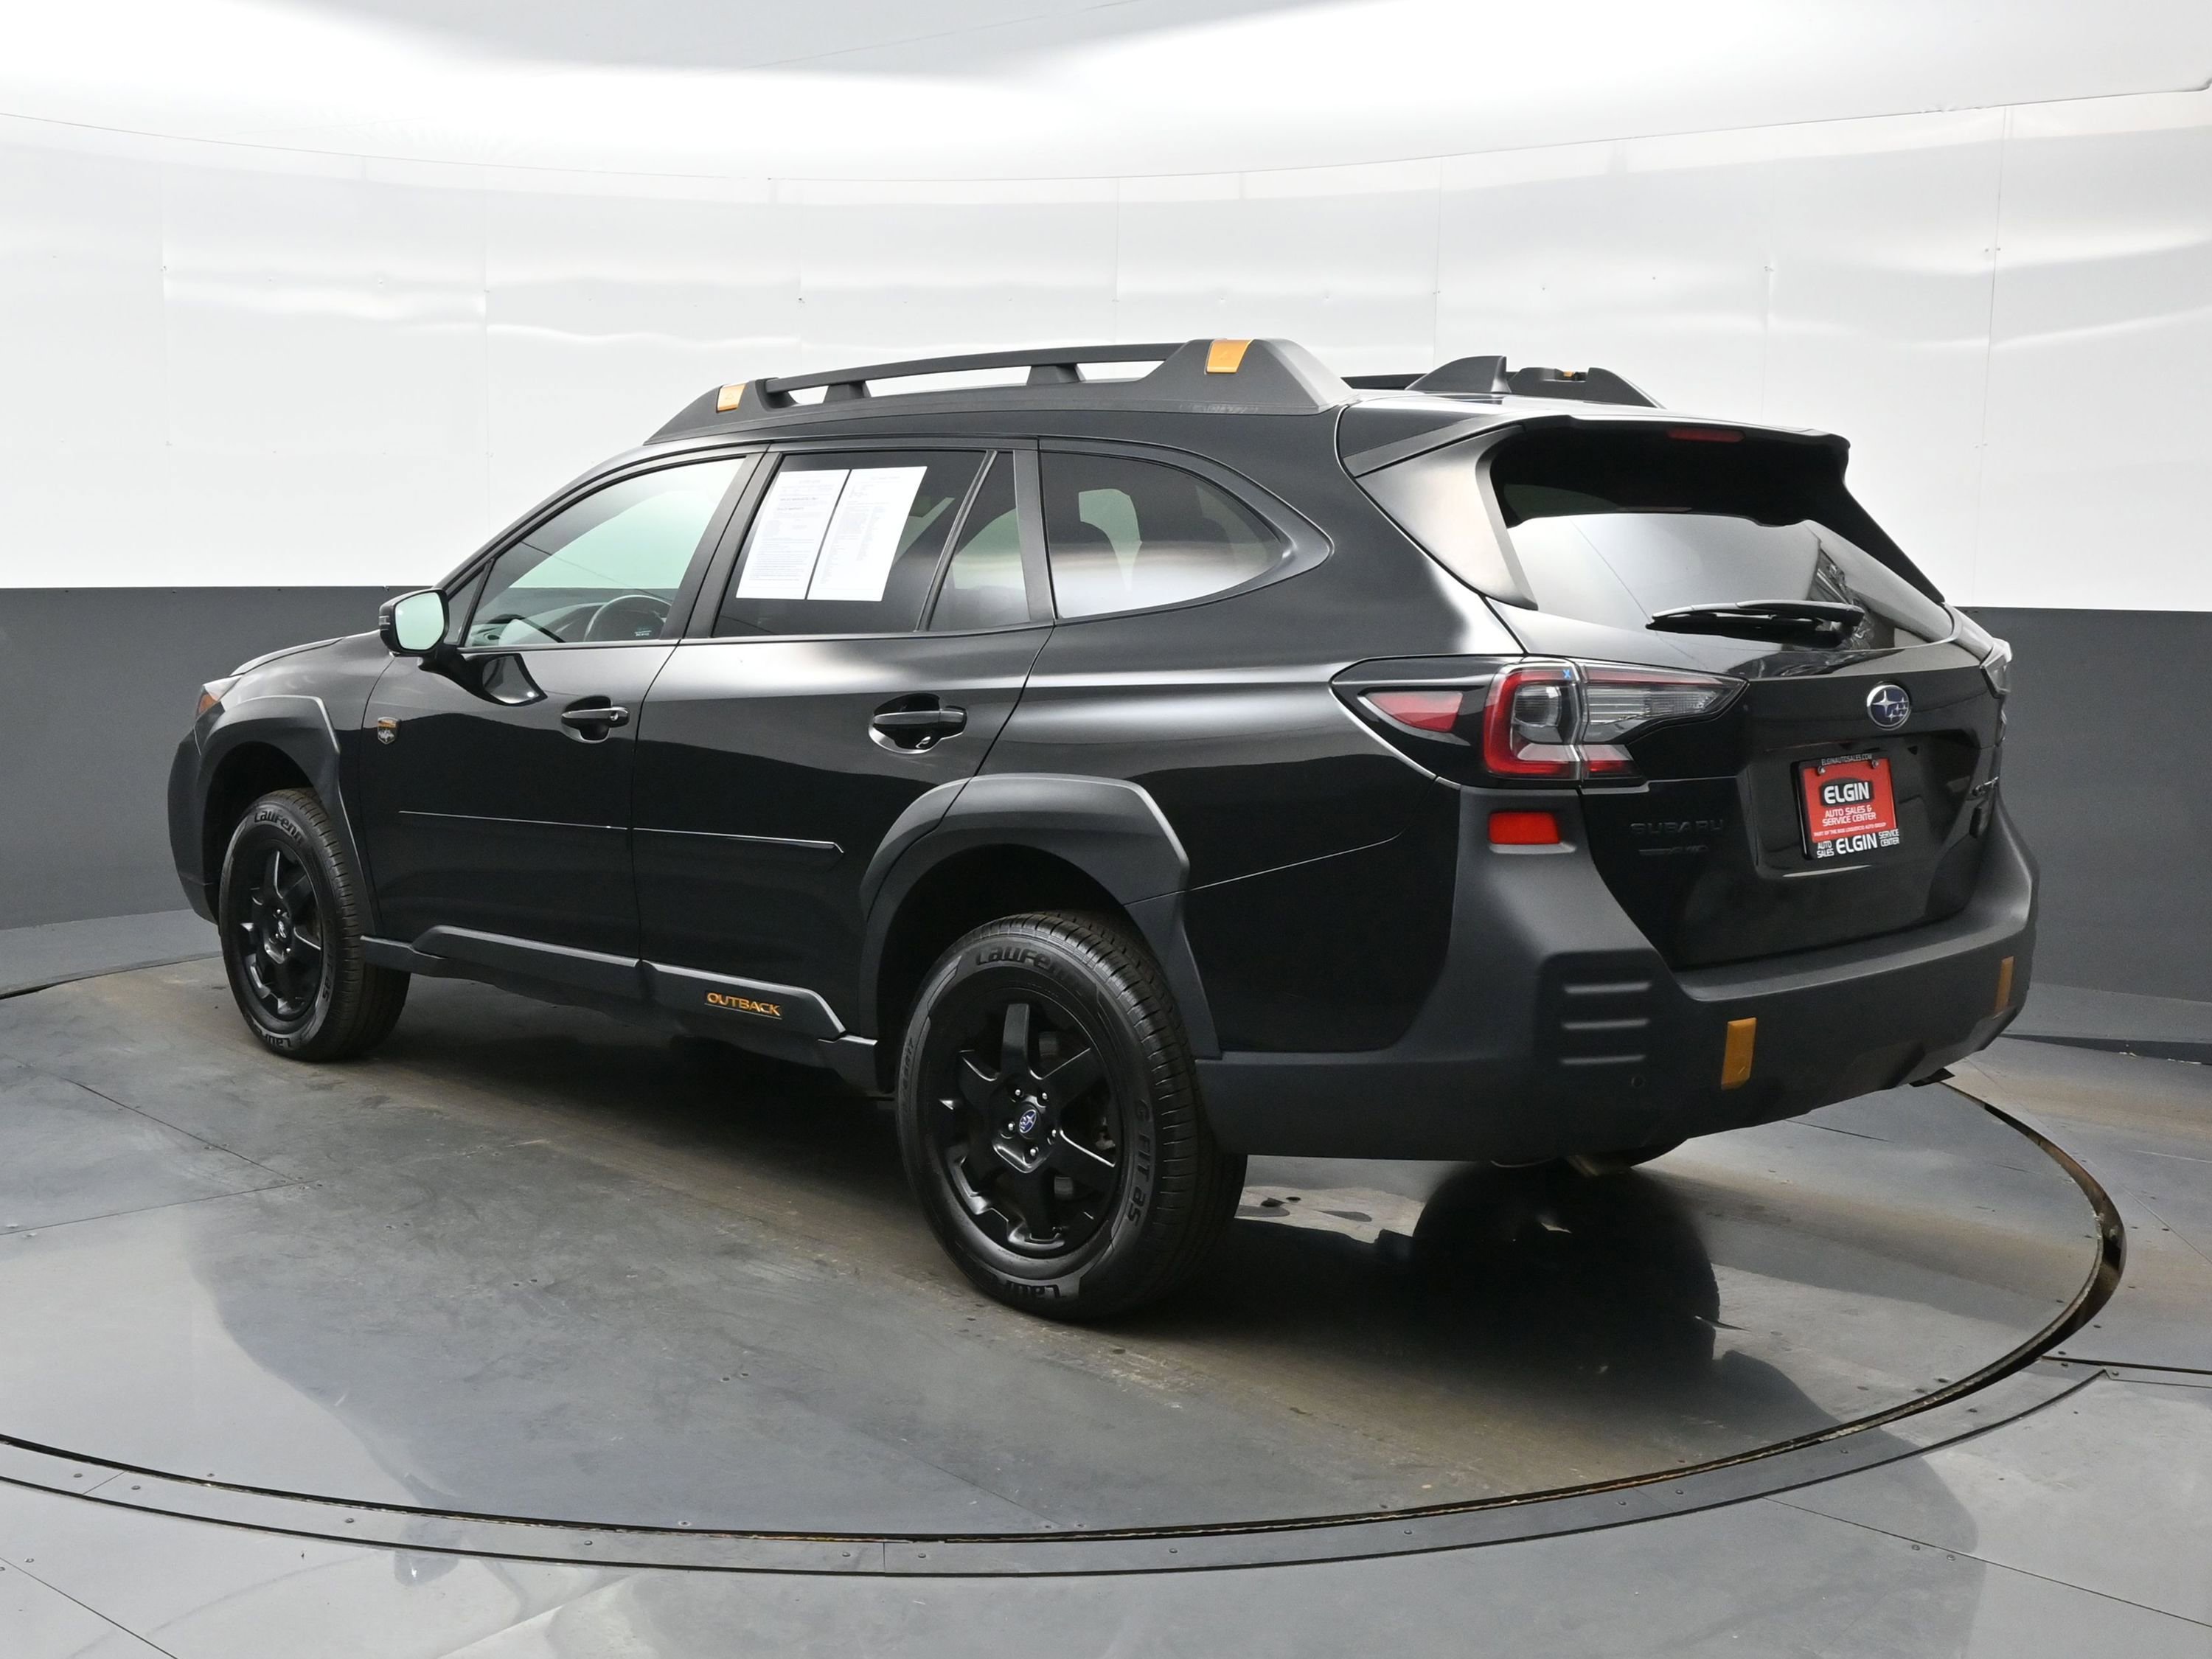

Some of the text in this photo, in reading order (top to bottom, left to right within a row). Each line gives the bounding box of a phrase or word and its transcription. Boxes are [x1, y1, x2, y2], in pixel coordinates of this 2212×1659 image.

[1823, 782, 1870, 804] ELGIN
[1822, 812, 1877, 827] SERVICE CENTER
[1825, 809, 1844, 818] AUTO
[1845, 806, 1865, 815] SALES
[1630, 819, 1723, 835] SUBARU
[1878, 829, 1899, 839] SERVICE
[1818, 841, 1832, 849] AUTO
[1836, 832, 1877, 855] ELGIN
[1880, 838, 1900, 847] CENTER
[1817, 848, 1834, 858] SALES
[706, 992, 781, 1017] OUTBACK
[1137, 1132, 1151, 1183] FIT
